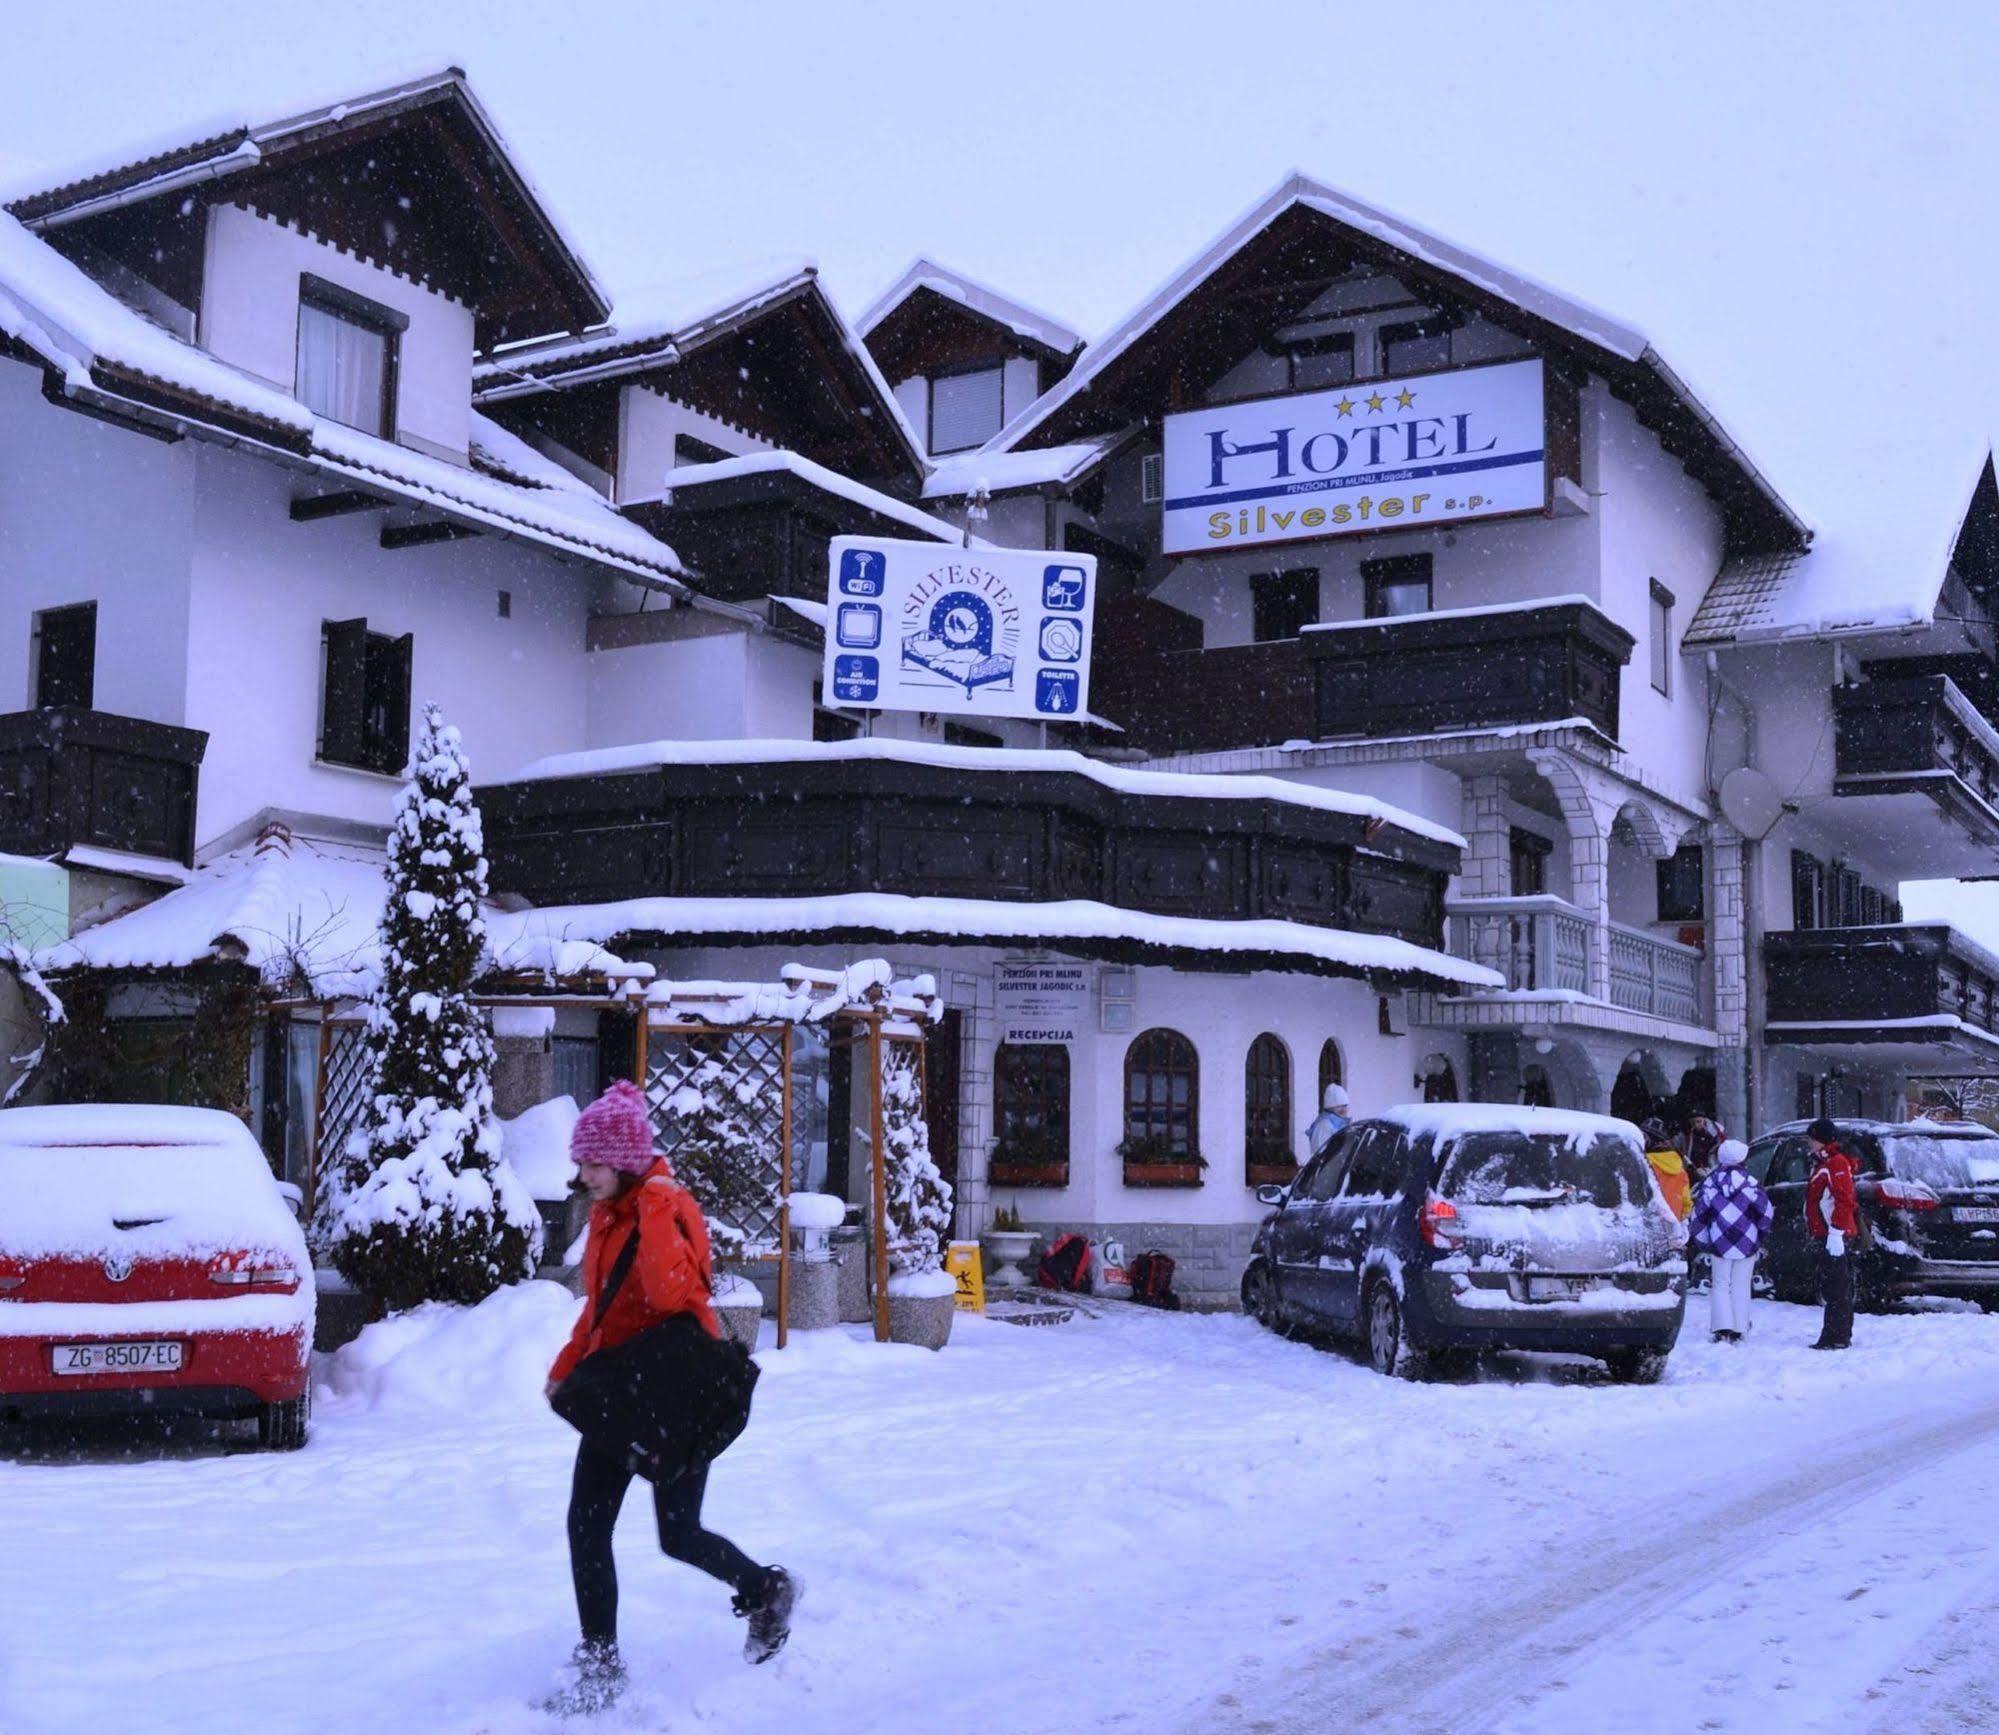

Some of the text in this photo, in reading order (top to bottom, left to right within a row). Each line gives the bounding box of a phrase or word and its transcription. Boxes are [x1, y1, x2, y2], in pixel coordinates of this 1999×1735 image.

[1204, 413, 1498, 489] HOTEL
[1286, 480, 1328, 493] PENZION
[1330, 478, 1343, 488] PRI
[1208, 492, 1492, 540] Silvester s.p.
[903, 565, 1020, 625] SILVESTER
[999, 982, 1037, 991] SILVESTER
[1009, 1030, 1074, 1040] RECEPCIJA
[68, 1347, 91, 1367] ZG
